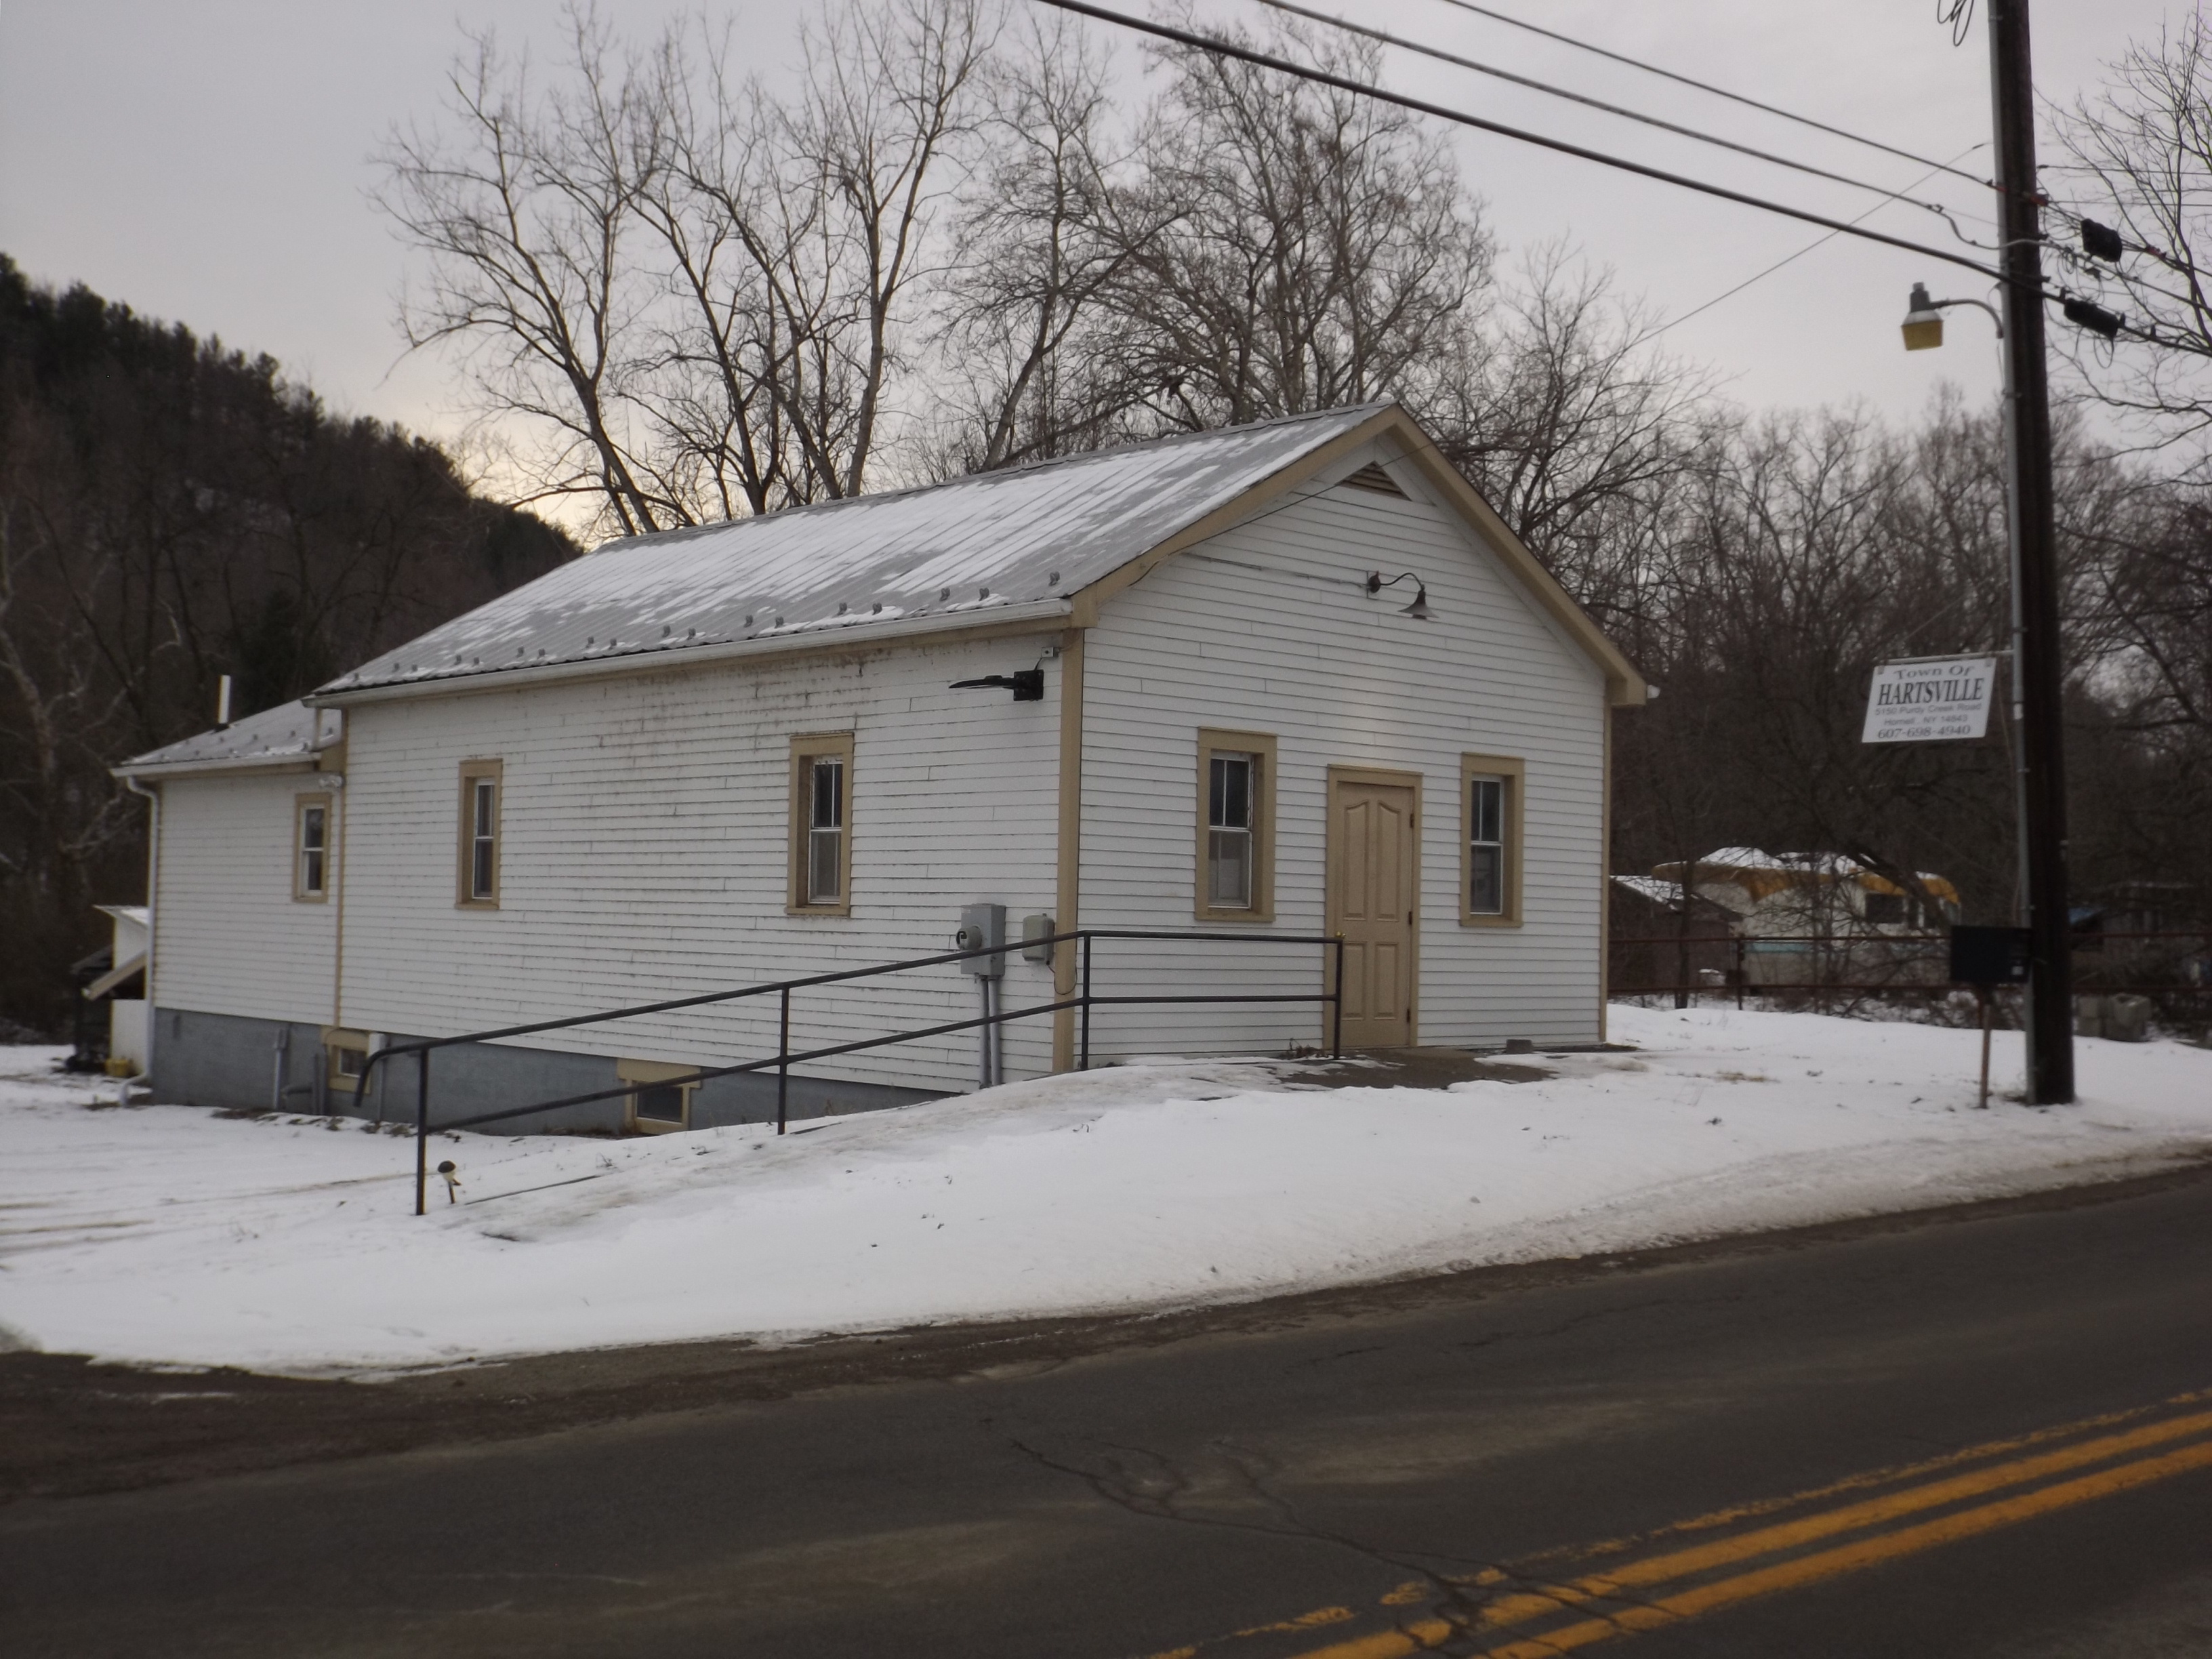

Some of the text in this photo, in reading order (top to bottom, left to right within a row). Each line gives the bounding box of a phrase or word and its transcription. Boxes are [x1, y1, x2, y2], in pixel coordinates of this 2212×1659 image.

[1894, 665, 1975, 679] Town Of
[1877, 678, 1984, 705] HARTSVILLE
[1877, 724, 1971, 739] 607-698-4940
